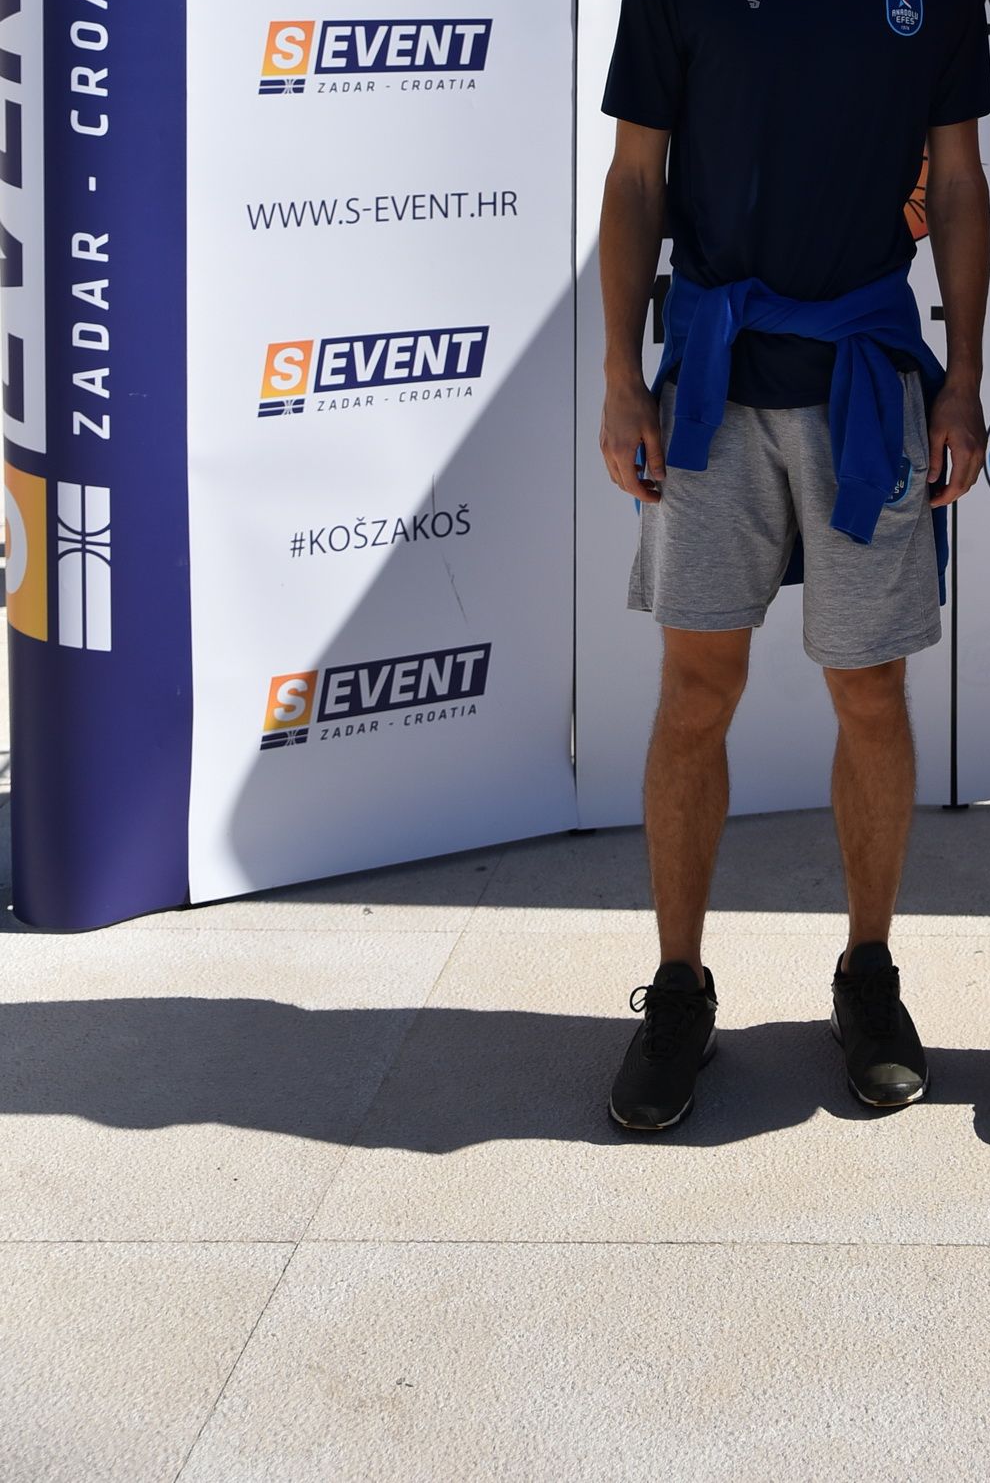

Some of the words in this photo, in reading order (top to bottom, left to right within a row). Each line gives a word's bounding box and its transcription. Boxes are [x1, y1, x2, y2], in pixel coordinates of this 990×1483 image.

[896, 16, 915, 25] EFES
[321, 25, 486, 68] EVENT
[317, 81, 375, 93] ZADAR
[401, 79, 476, 91] CROATIA
[247, 191, 518, 230] WWW.S-EVENT.HR
[71, 231, 110, 439] ZADAR
[320, 332, 483, 386] EVENT
[317, 395, 374, 412] ZADAR
[399, 386, 473, 402] CROATIA
[290, 503, 471, 558] #KOŠZAKOŠ
[324, 650, 485, 715] EVENT
[320, 720, 378, 740] ZADAR
[404, 704, 477, 726] CROATIA
